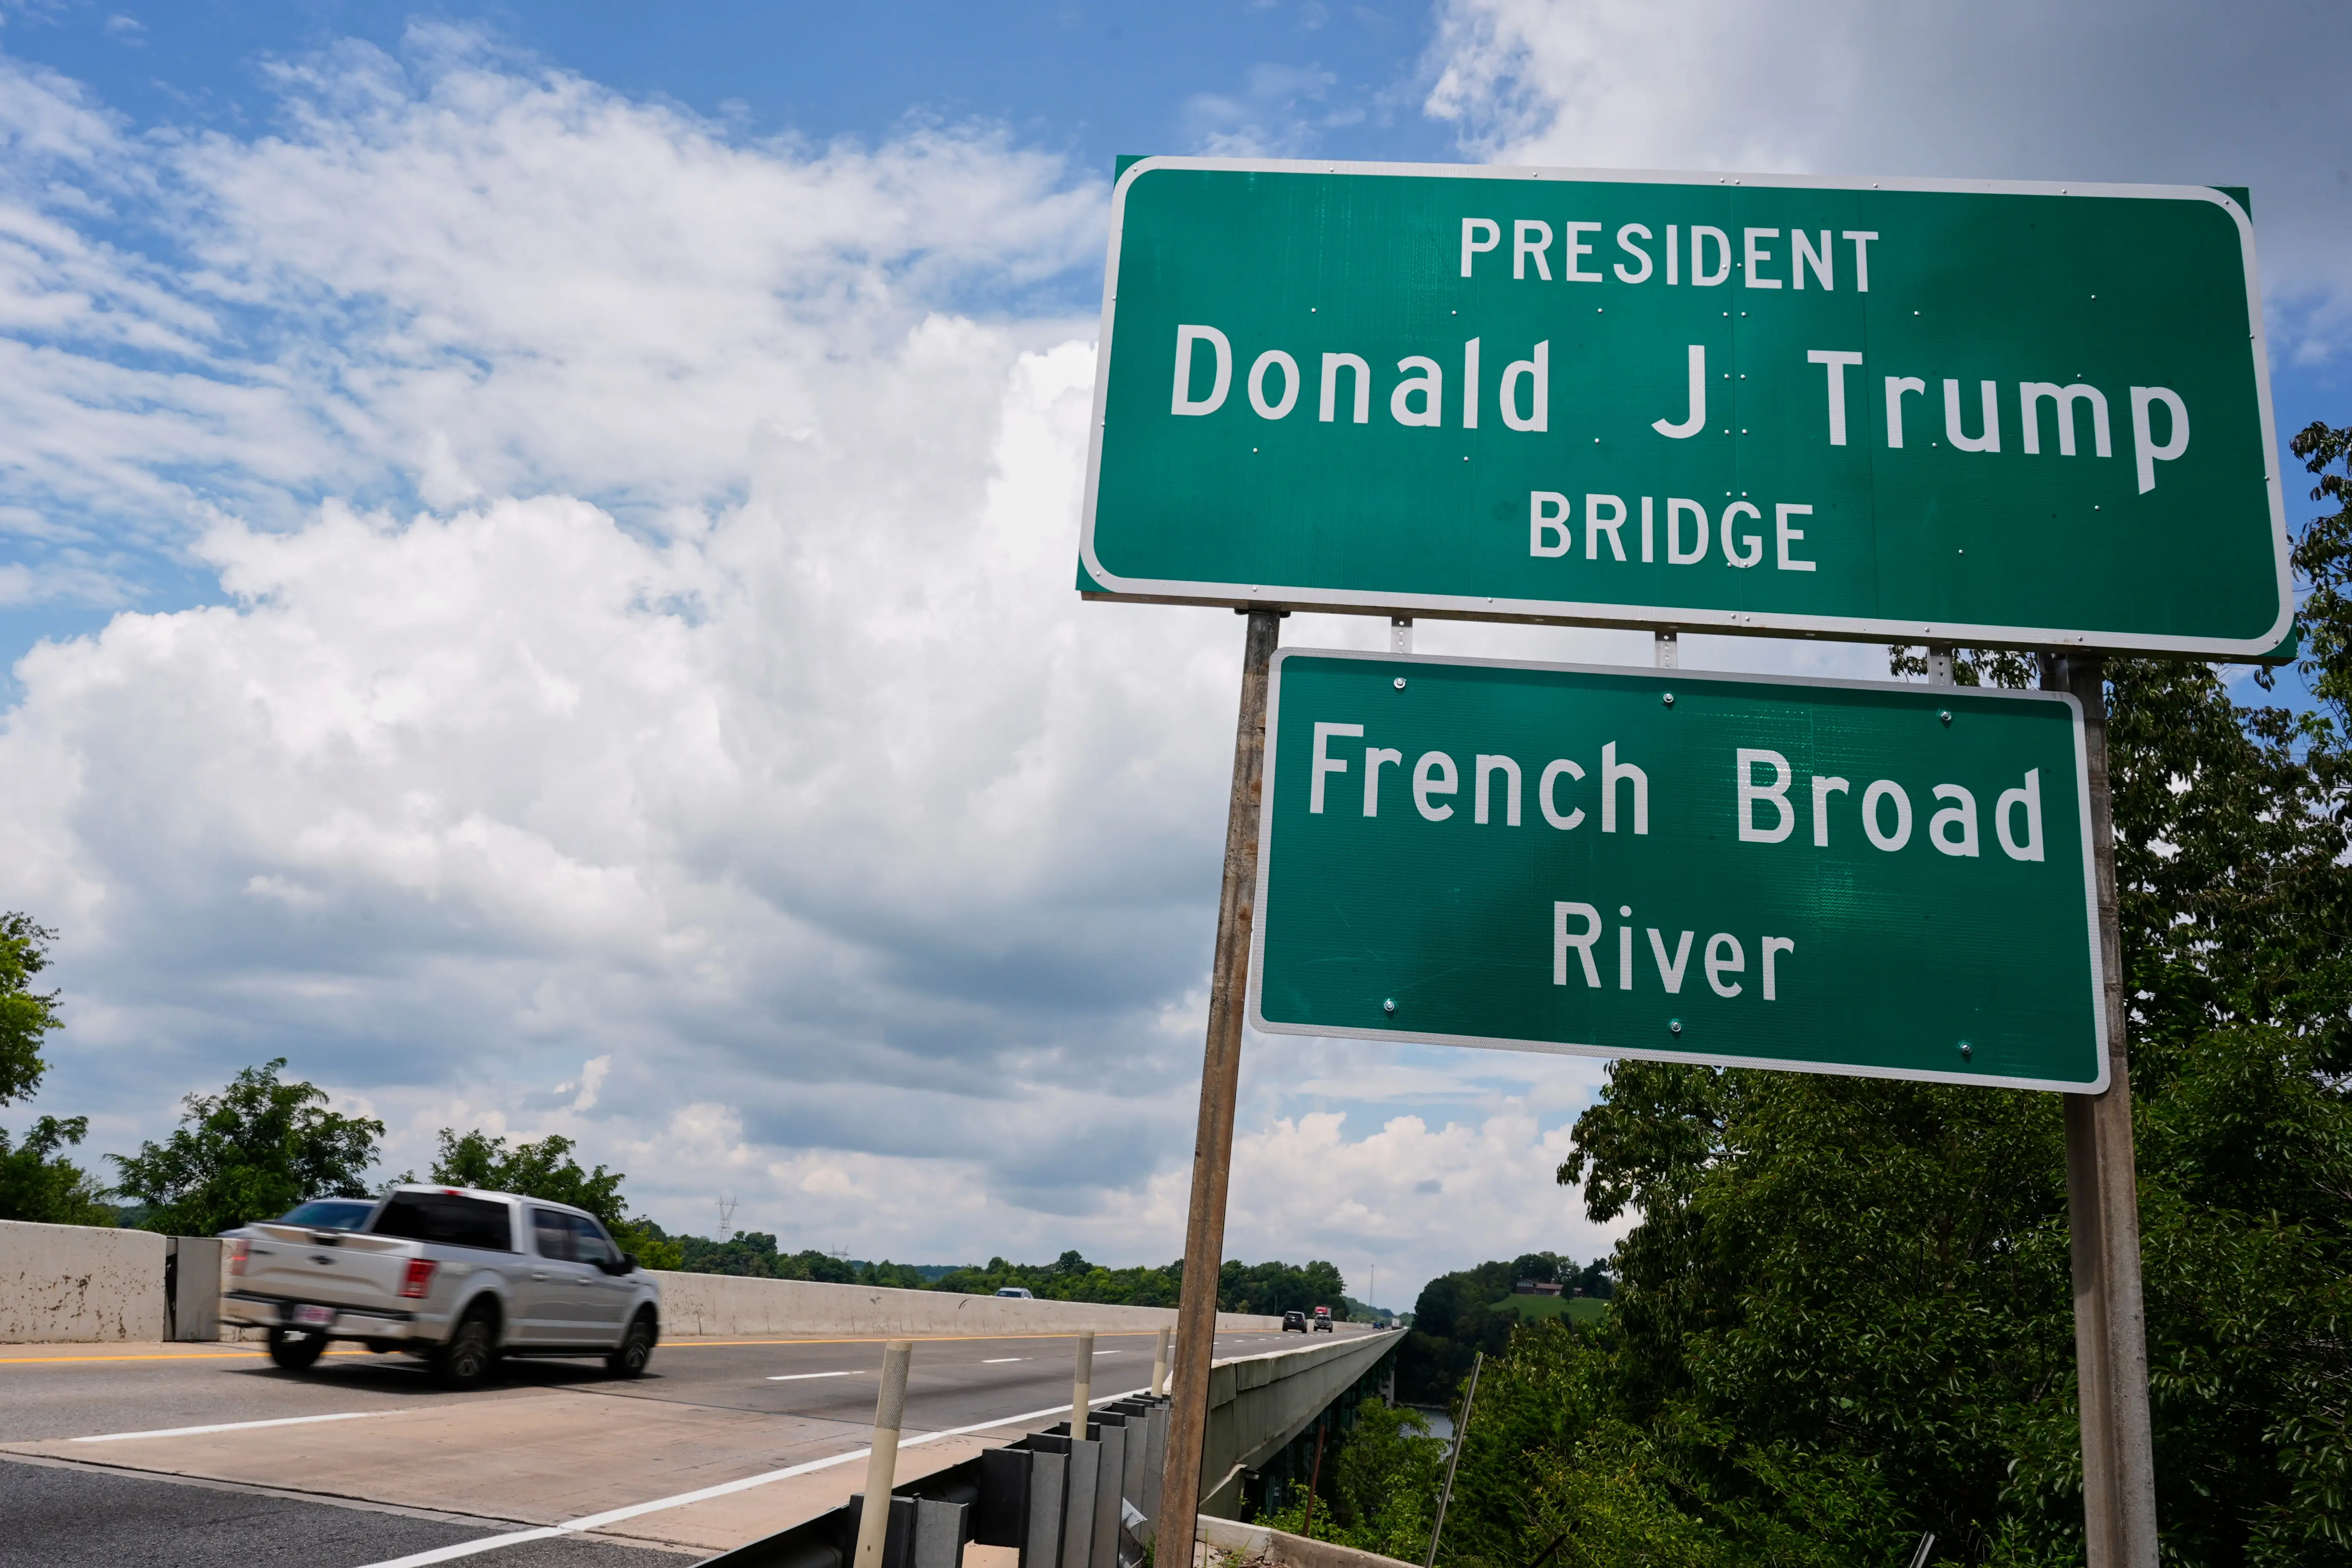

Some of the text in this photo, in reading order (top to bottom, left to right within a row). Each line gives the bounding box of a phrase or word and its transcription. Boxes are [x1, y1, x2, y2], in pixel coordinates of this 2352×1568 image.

[1461, 217, 1879, 292] PRESIDENT
[1171, 324, 2190, 495] Donald J Trump
[1530, 491, 1817, 571] BRIDGE
[1310, 722, 2045, 862] French Broad
[1553, 901, 1795, 1001] River
